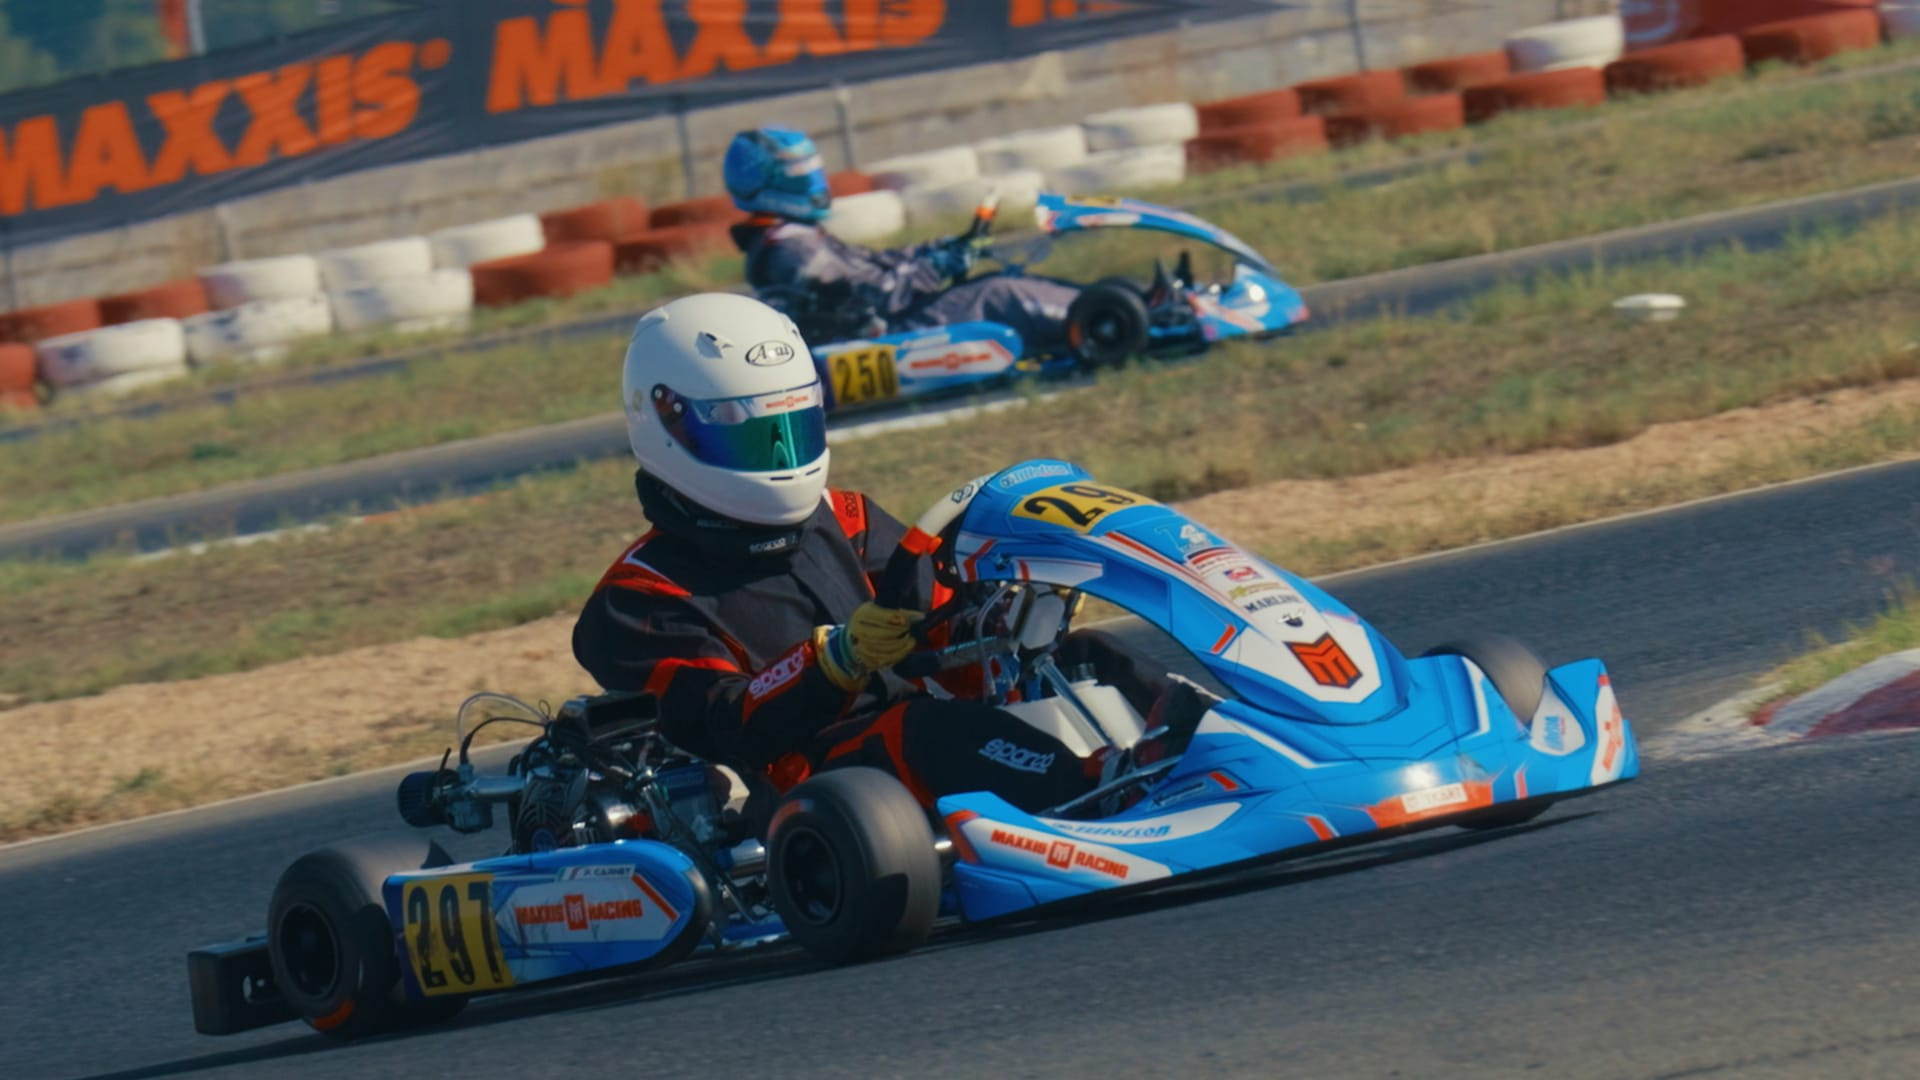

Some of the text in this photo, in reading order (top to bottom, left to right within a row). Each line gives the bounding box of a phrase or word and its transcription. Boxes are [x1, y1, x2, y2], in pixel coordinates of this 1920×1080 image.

[0, 42, 421, 214] MAXXIS
[752, 344, 790, 362] Aai
[836, 351, 895, 402] 250
[749, 646, 805, 699] sparco
[979, 738, 1056, 773] sparco
[991, 829, 1048, 855] MAXXIS
[1075, 851, 1130, 879] RACING
[407, 879, 503, 989] 297
